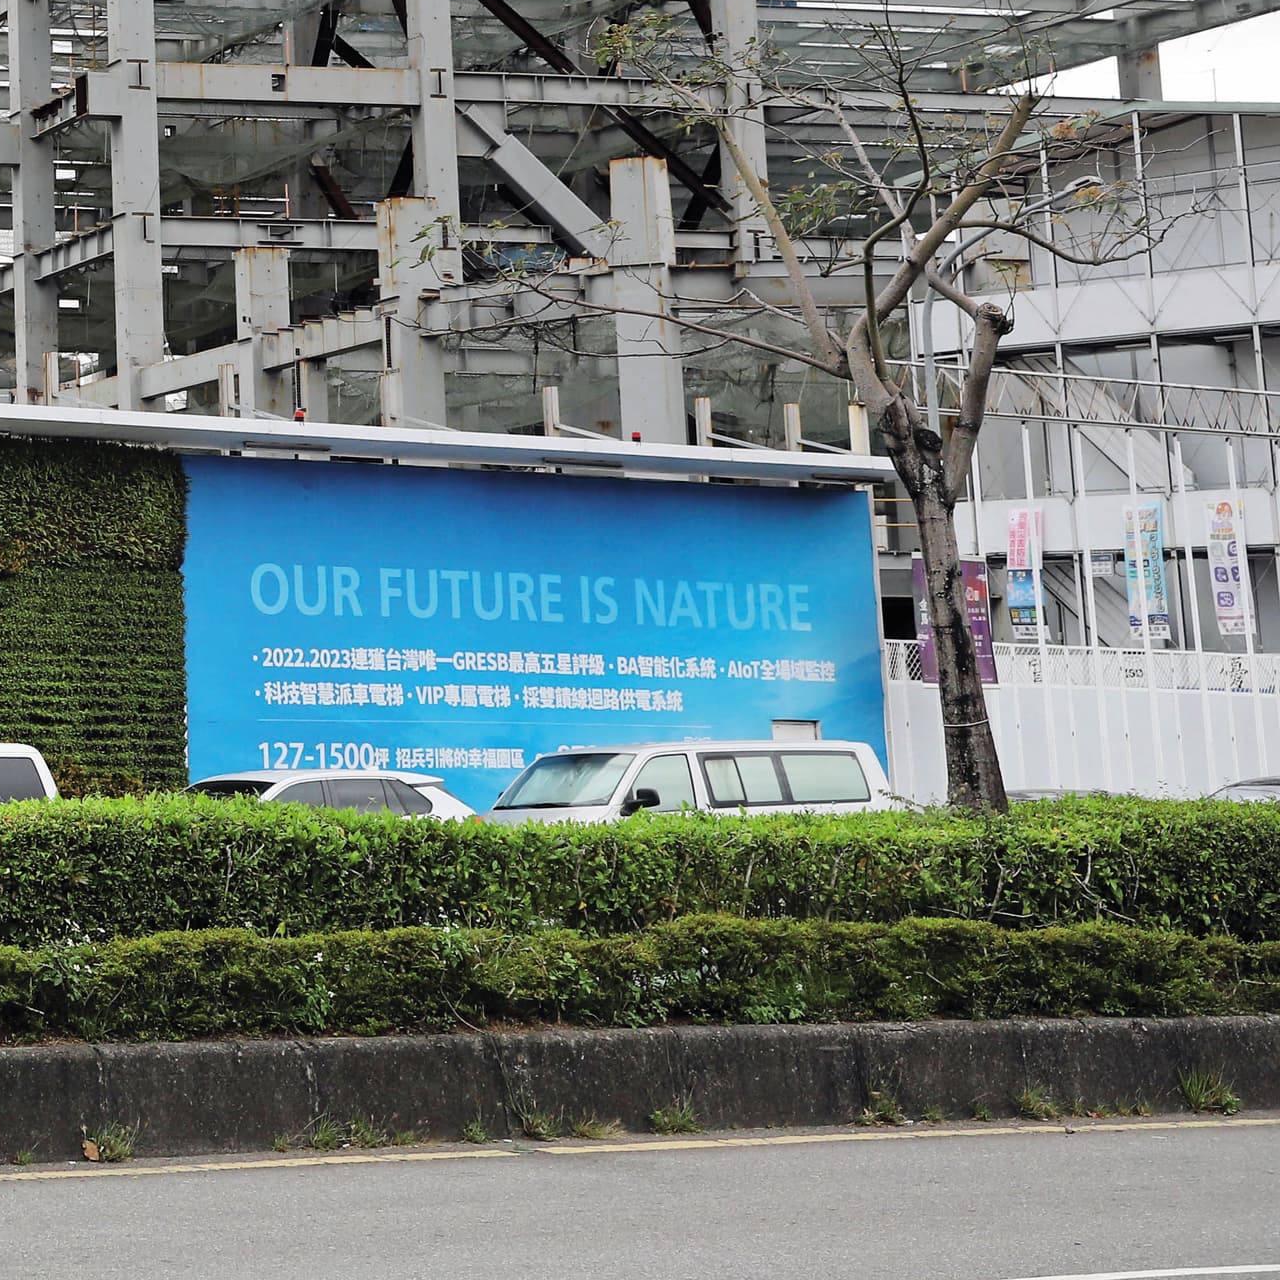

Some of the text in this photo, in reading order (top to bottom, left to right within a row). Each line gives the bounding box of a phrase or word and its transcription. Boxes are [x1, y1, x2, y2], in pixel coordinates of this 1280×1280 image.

[250, 562, 813, 632] OUR FUTURE IS NATURE
[258, 742, 389, 770] 127-1500坪
